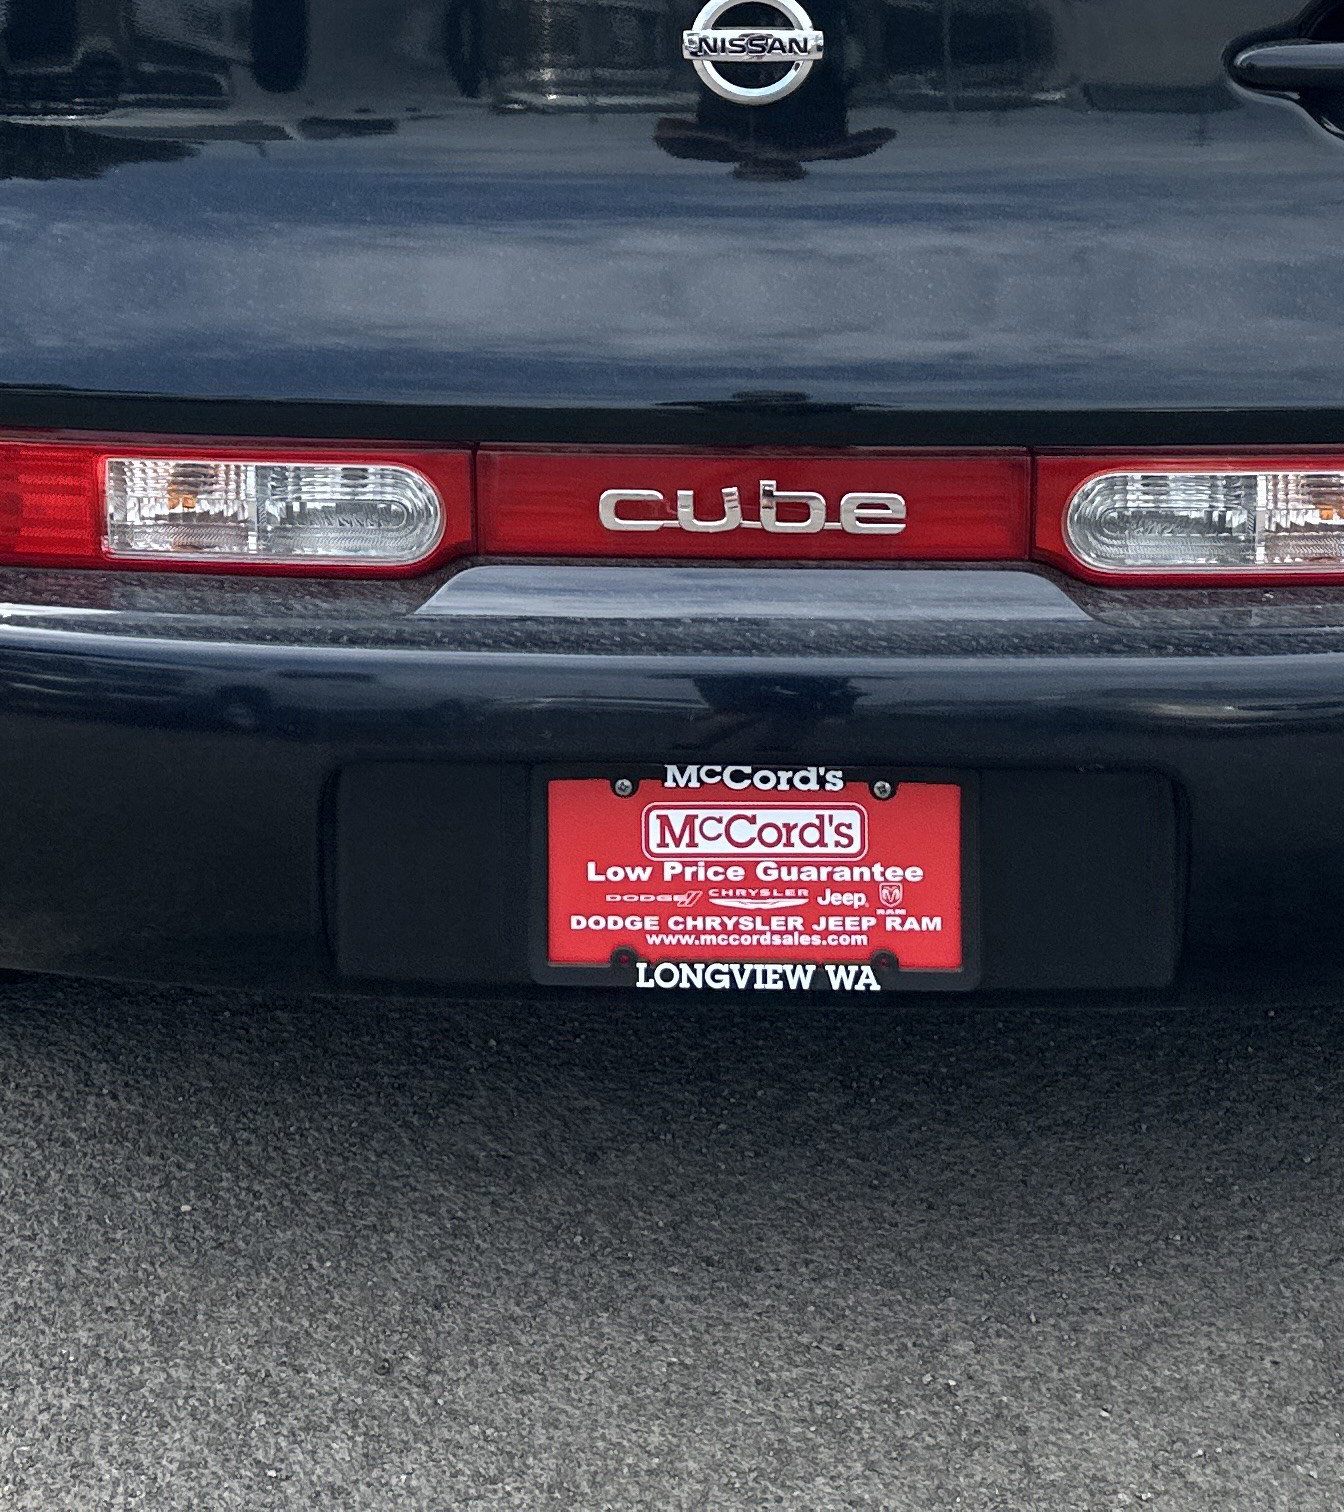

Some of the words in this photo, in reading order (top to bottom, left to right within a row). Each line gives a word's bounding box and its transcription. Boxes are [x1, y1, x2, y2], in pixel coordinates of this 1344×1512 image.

[698, 37, 809, 54] NISSAN
[599, 480, 907, 534] cube
[663, 764, 845, 791] McCord's
[656, 814, 855, 848] McCord's
[587, 861, 653, 882] Low
[663, 861, 746, 882] Price
[756, 861, 924, 882] Guarantee
[605, 894, 687, 903] DODGE
[709, 889, 809, 897] CHRYSLER
[817, 888, 867, 909] Jeep
[570, 915, 660, 930] DODGE
[667, 915, 804, 931] CHRYSLER
[812, 916, 877, 931] JEEP
[885, 916, 942, 931] RAM
[645, 932, 869, 946] www.mccordsales.com
[636, 962, 817, 990] LONGVIEW
[825, 964, 881, 991] WA
